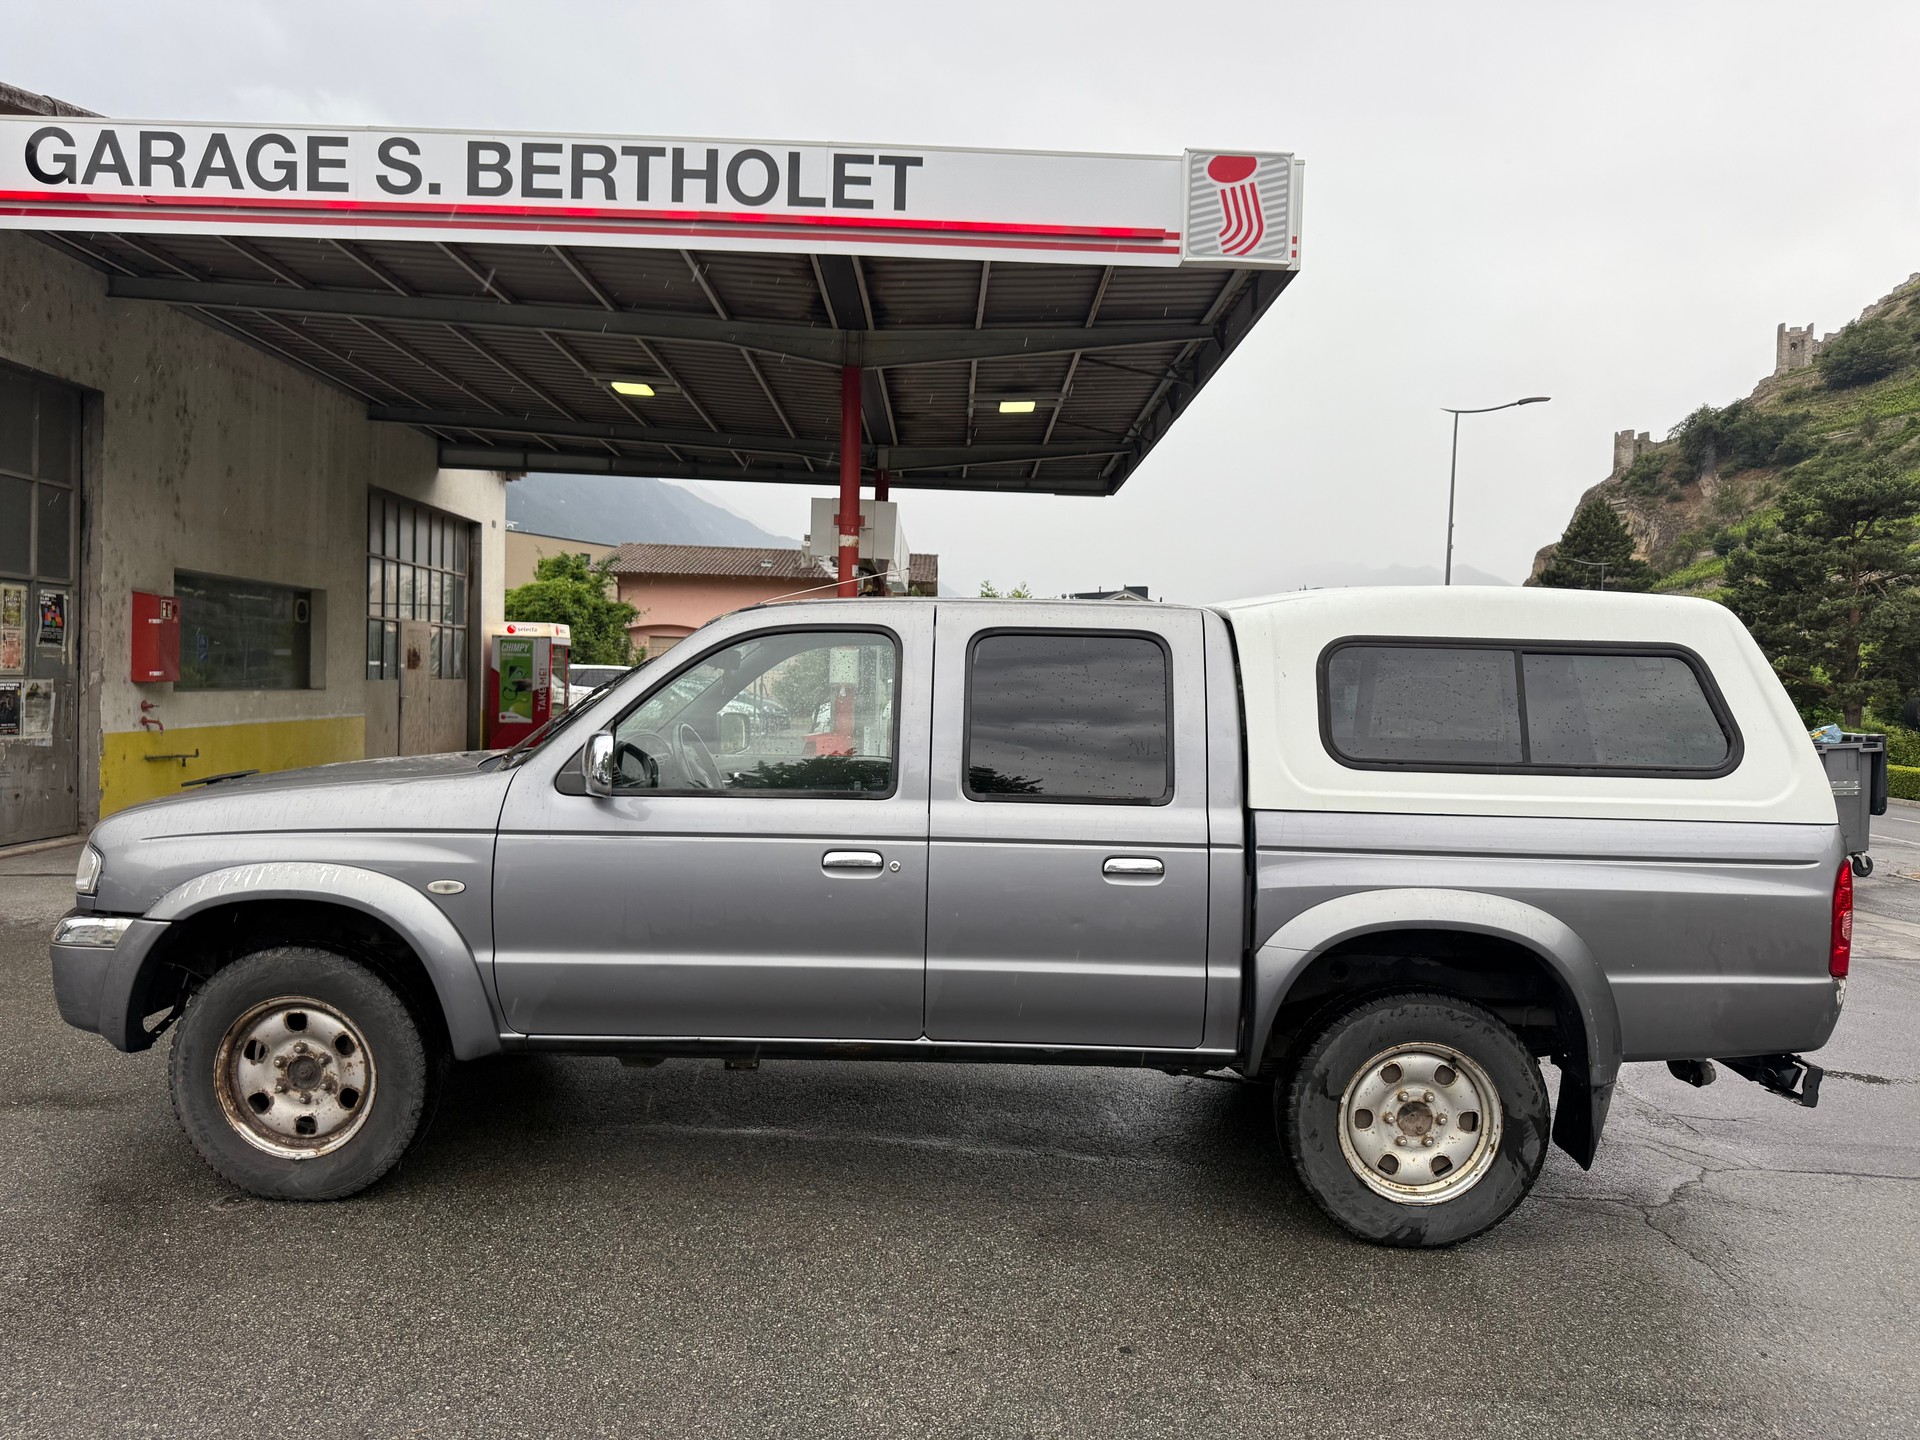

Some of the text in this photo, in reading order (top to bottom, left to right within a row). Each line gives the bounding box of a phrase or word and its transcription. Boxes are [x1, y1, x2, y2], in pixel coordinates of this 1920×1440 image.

[24, 126, 924, 211] GARAGE S. BERTHOLET
[501, 642, 530, 653] CHIMPY
[537, 686, 547, 712] TAKE
